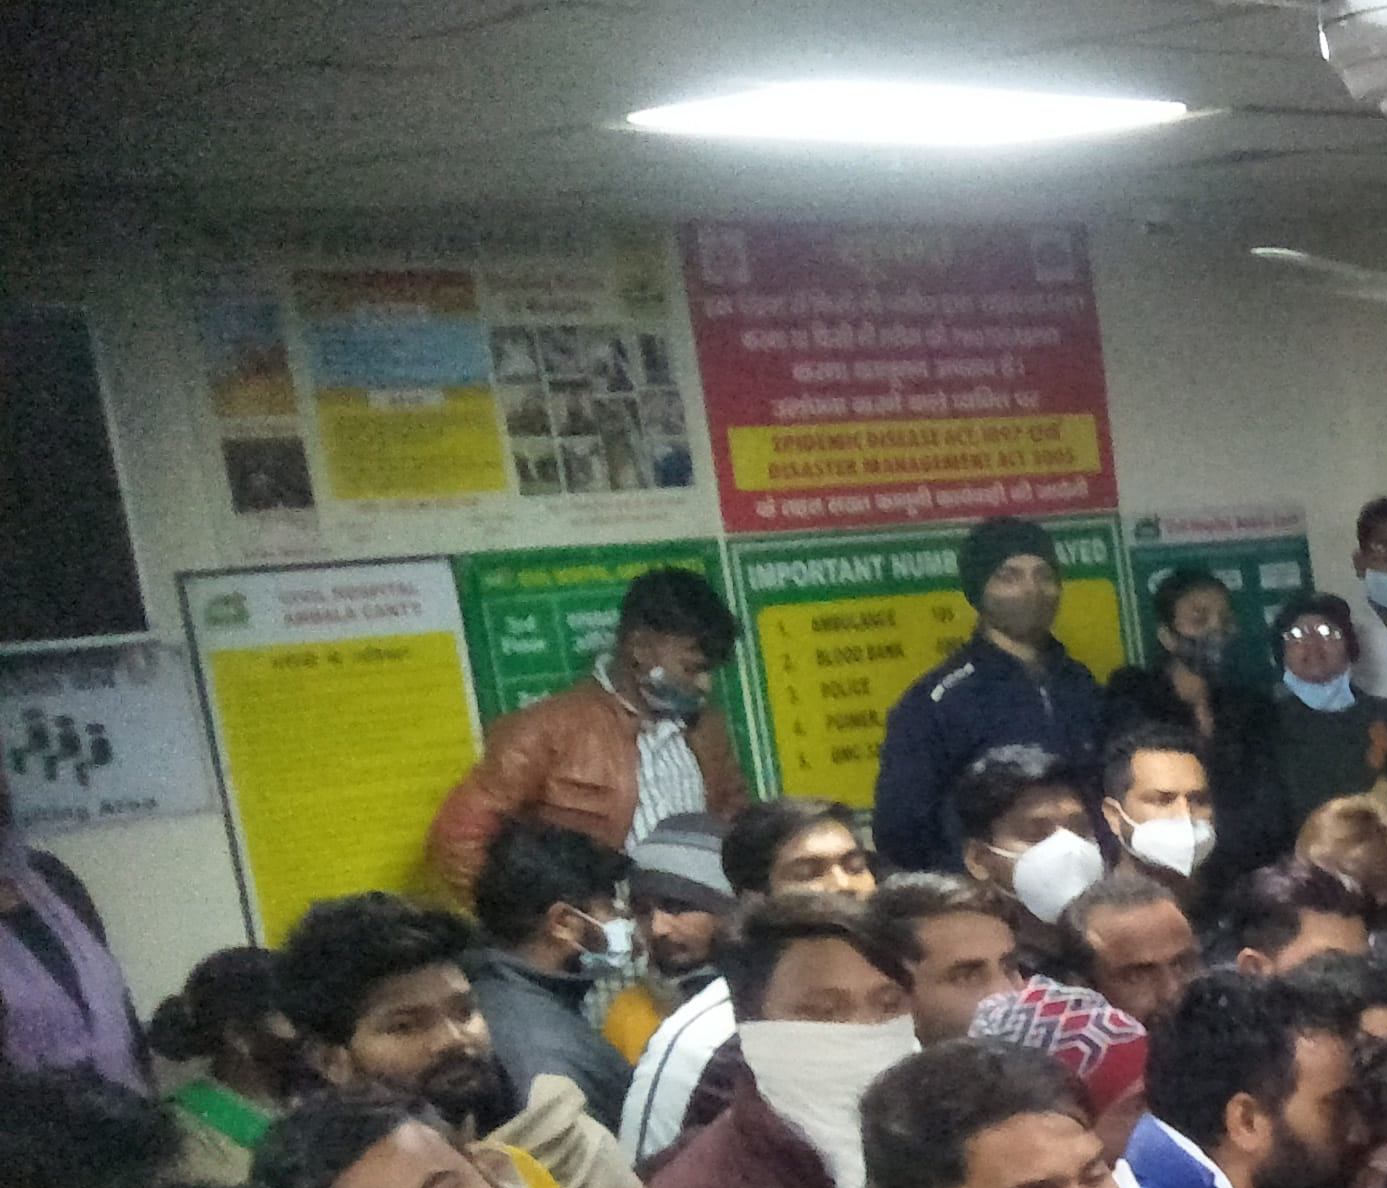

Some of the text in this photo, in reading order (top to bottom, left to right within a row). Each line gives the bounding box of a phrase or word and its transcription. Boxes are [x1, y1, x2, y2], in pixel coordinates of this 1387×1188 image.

[768, 457, 857, 480] DISASTER
[862, 452, 991, 474] MANAGEMENT
[997, 449, 1026, 468] ACT
[749, 554, 884, 590] IMPORTANT
